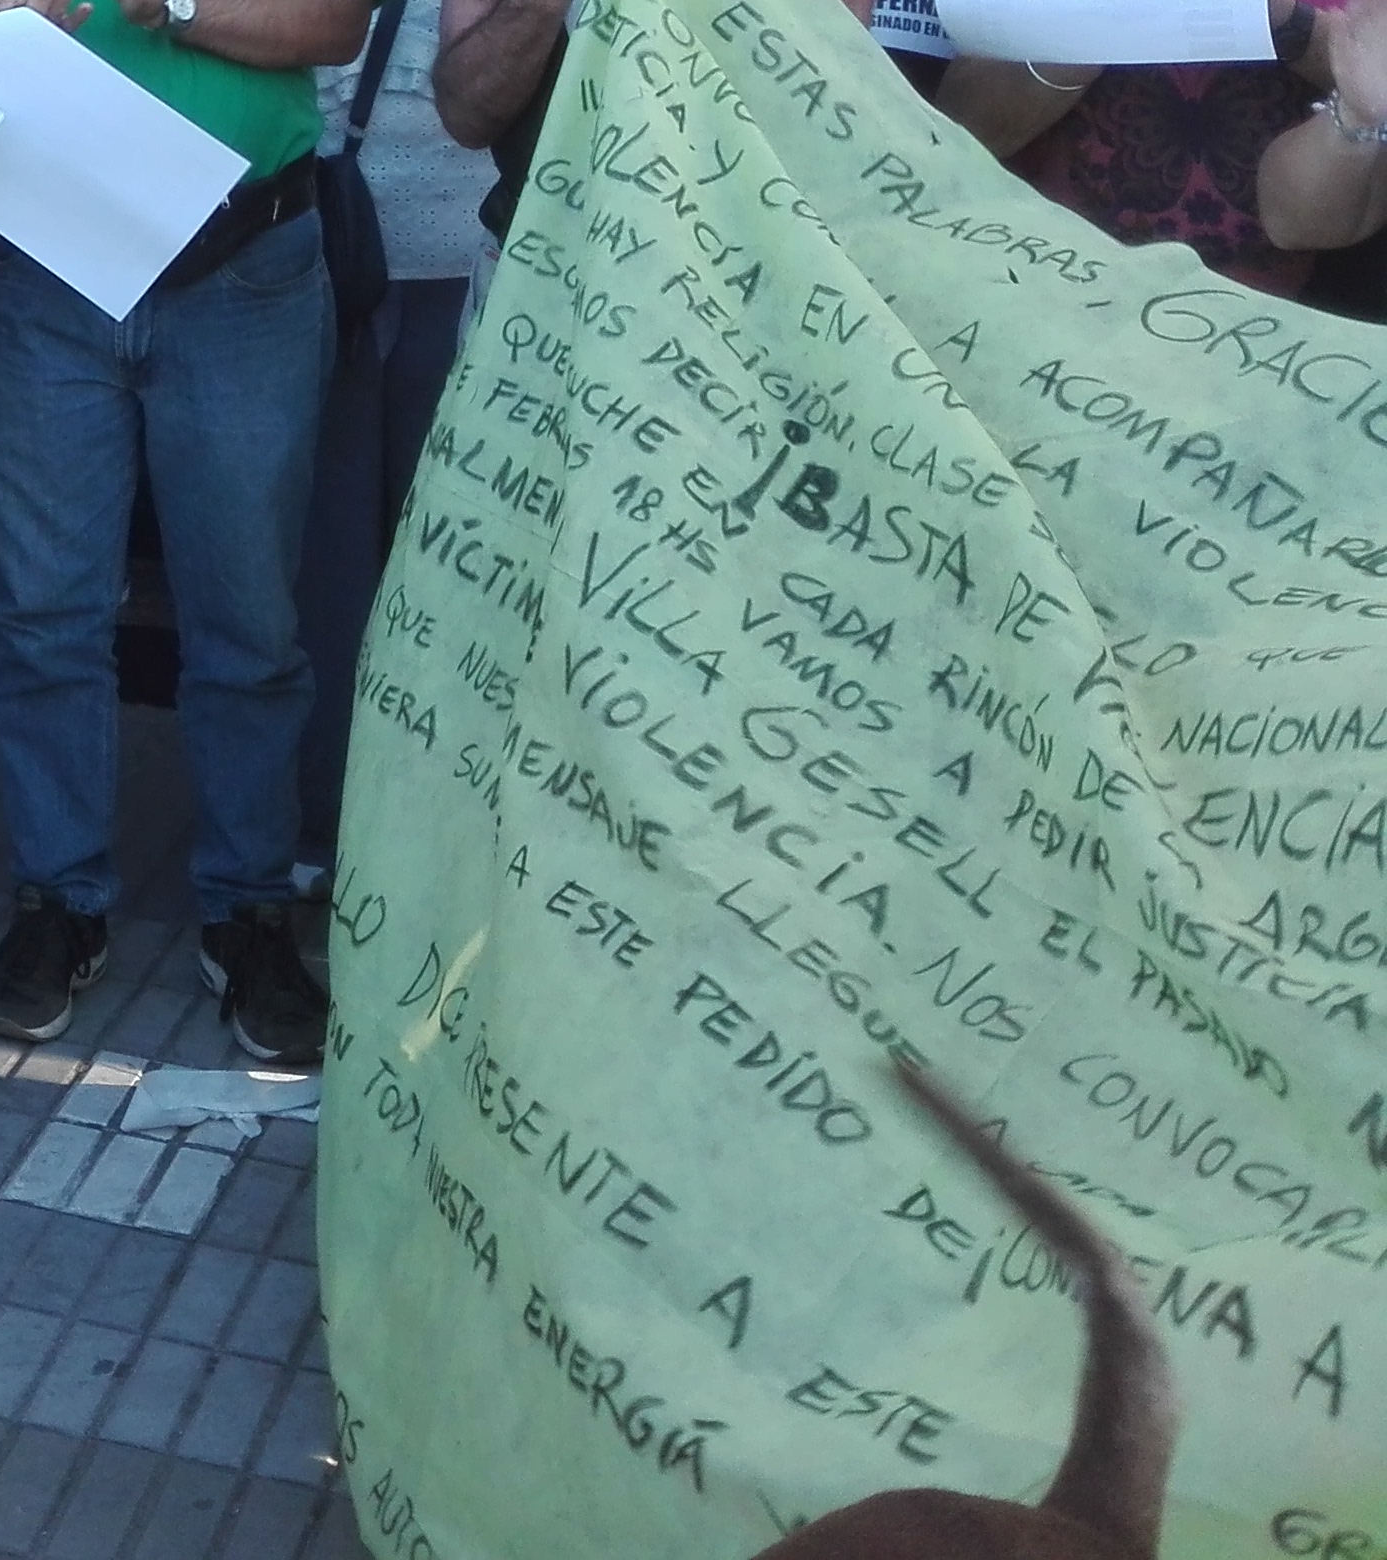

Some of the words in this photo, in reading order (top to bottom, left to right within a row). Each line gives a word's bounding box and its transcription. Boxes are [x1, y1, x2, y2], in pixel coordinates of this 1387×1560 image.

[710, 0, 858, 142] ESTAS
[861, 151, 1108, 284] PALABRAS
[586, 210, 658, 264] HAY
[869, 422, 1020, 507] CLASE
[696, 139, 745, 186] Y
[1010, 443, 1081, 496] LA
[800, 283, 869, 345] EN
[386, 584, 437, 648] QUE
[641, 337, 766, 460] DECIR
[995, 570, 1073, 643] DE
[578, 531, 727, 696] VILLA
[741, 704, 1004, 921] GESELL
[1039, 907, 1103, 975] EL
[612, 473, 665, 522] 18
[741, 597, 904, 733] VAMOS
[932, 750, 975, 798] A
[1003, 787, 1116, 893] PEDIR
[781, 572, 898, 664] CADA
[1072, 746, 1144, 811] DE
[505, 844, 530, 889] A
[545, 879, 656, 969] ESTE
[672, 971, 874, 1147] PEDIDO
[880, 1182, 977, 1261] DE
[1290, 1321, 1348, 1419] A
[912, 944, 1033, 1042] NOS
[699, 1275, 755, 1351] A
[786, 1366, 956, 1467] ESTE
